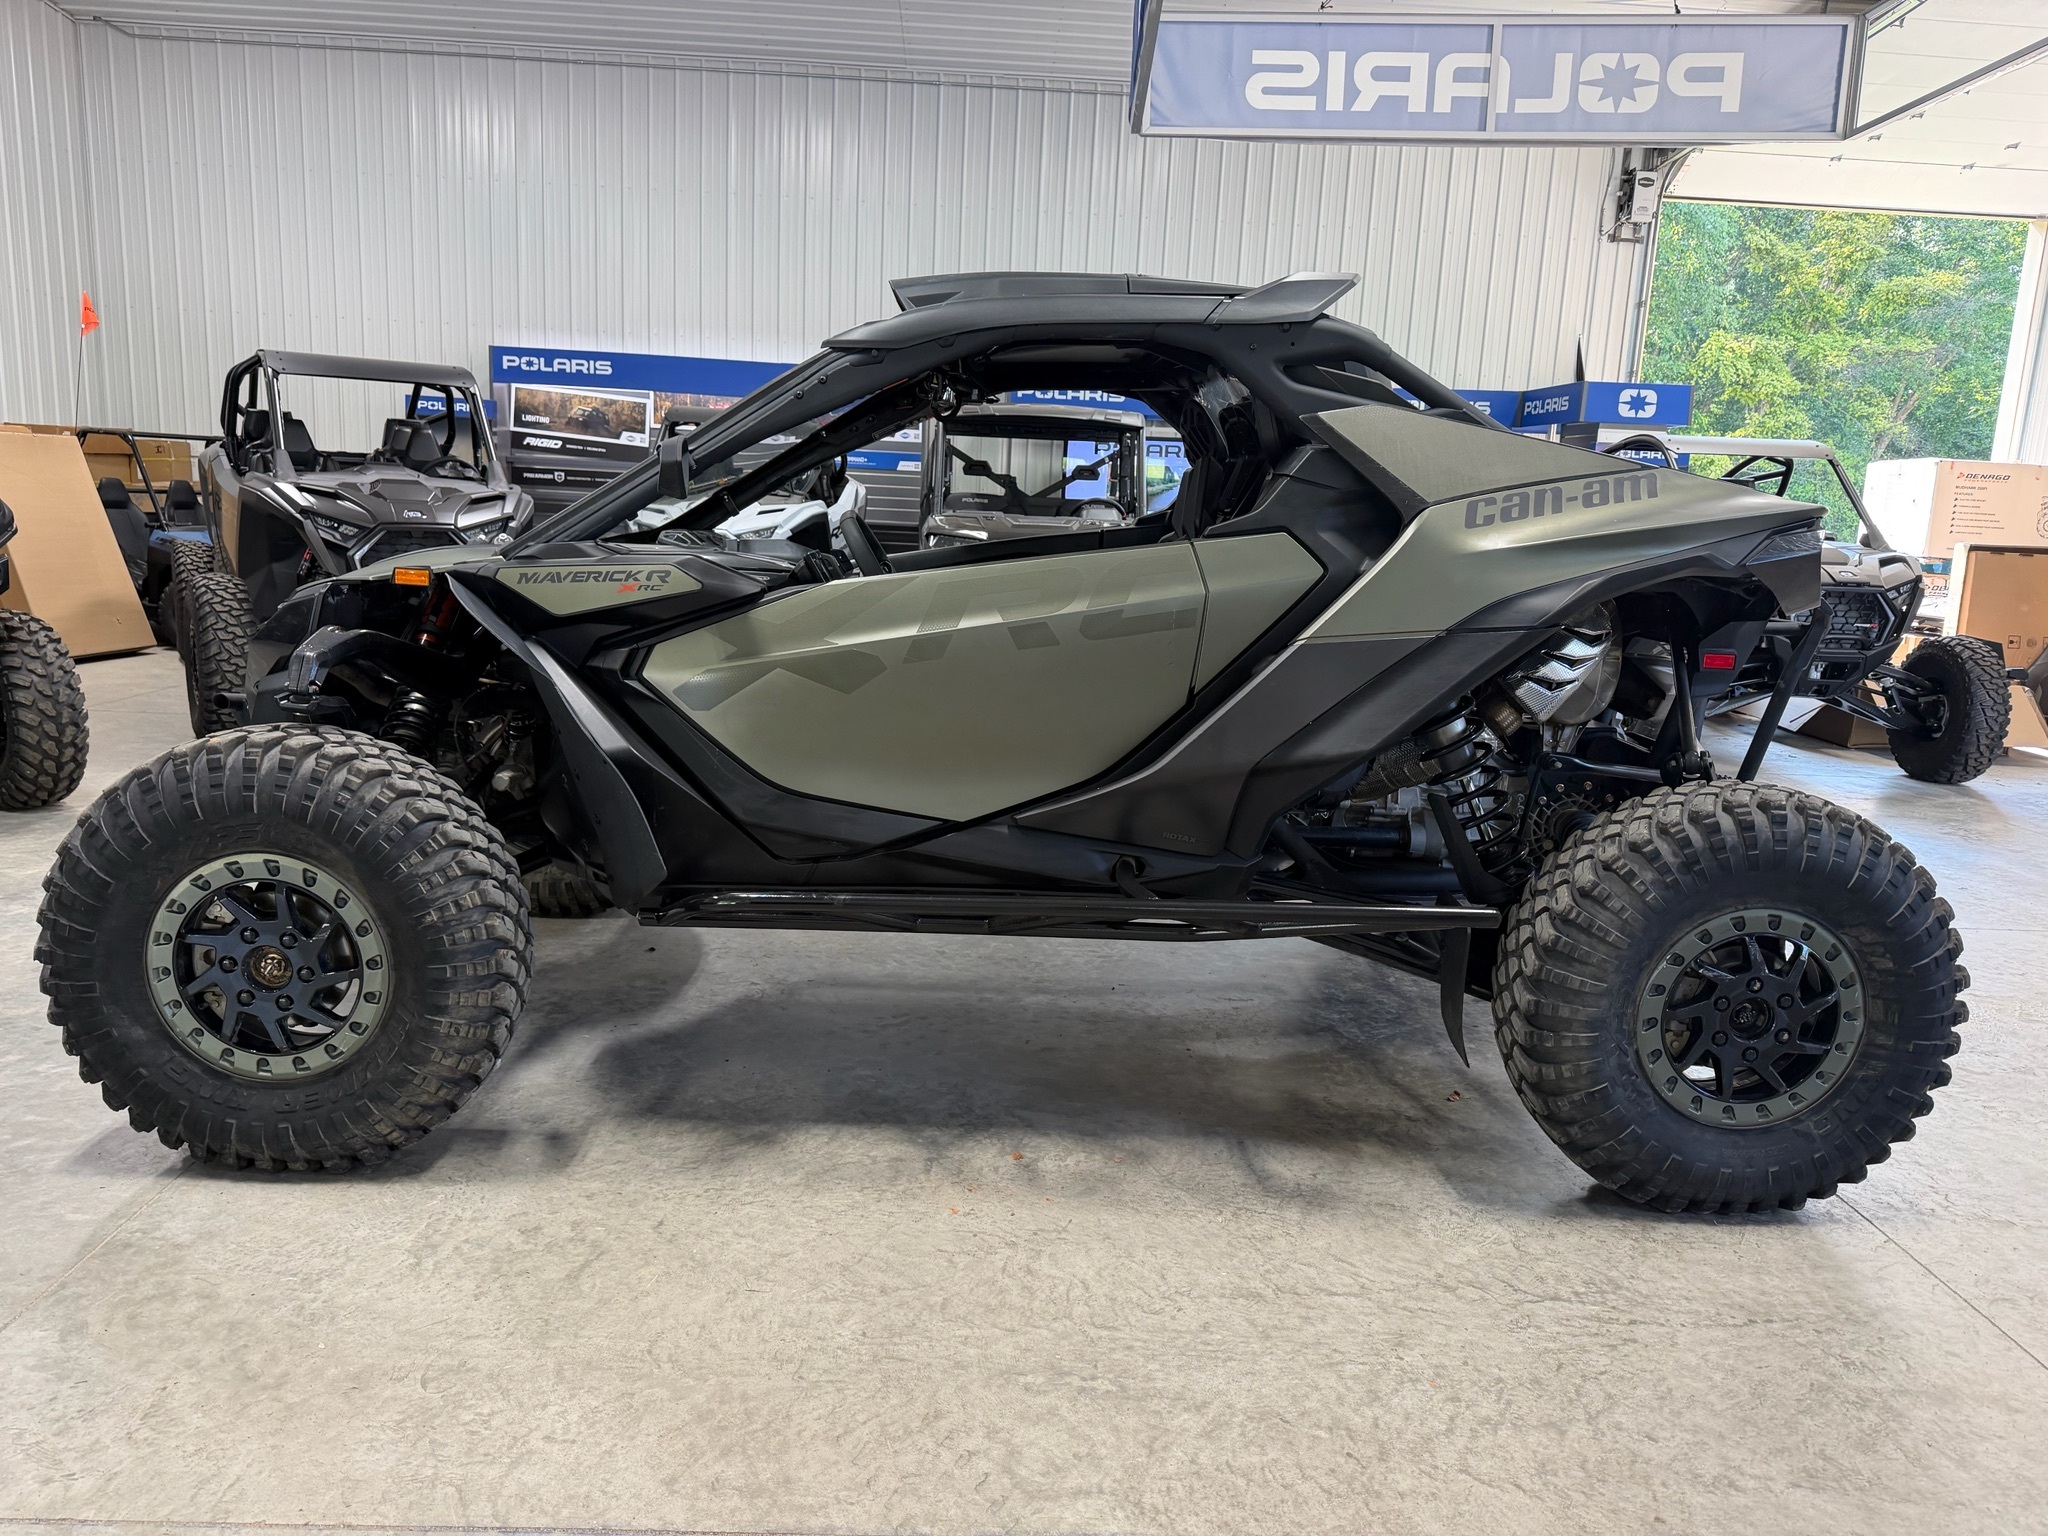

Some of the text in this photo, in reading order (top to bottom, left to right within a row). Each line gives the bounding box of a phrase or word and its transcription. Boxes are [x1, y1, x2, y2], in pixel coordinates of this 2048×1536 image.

[502, 355, 613, 376] POLARIS
[417, 400, 471, 412] POLRI
[1524, 396, 1569, 415] POLARIS
[521, 414, 550, 424] LIGHTING
[523, 436, 563, 449] RIGID
[1965, 473, 2011, 481] DENAGO
[1464, 472, 1659, 530] can-am
[516, 569, 672, 585] MAVERICK R
[1162, 831, 1198, 844] ROTAX
